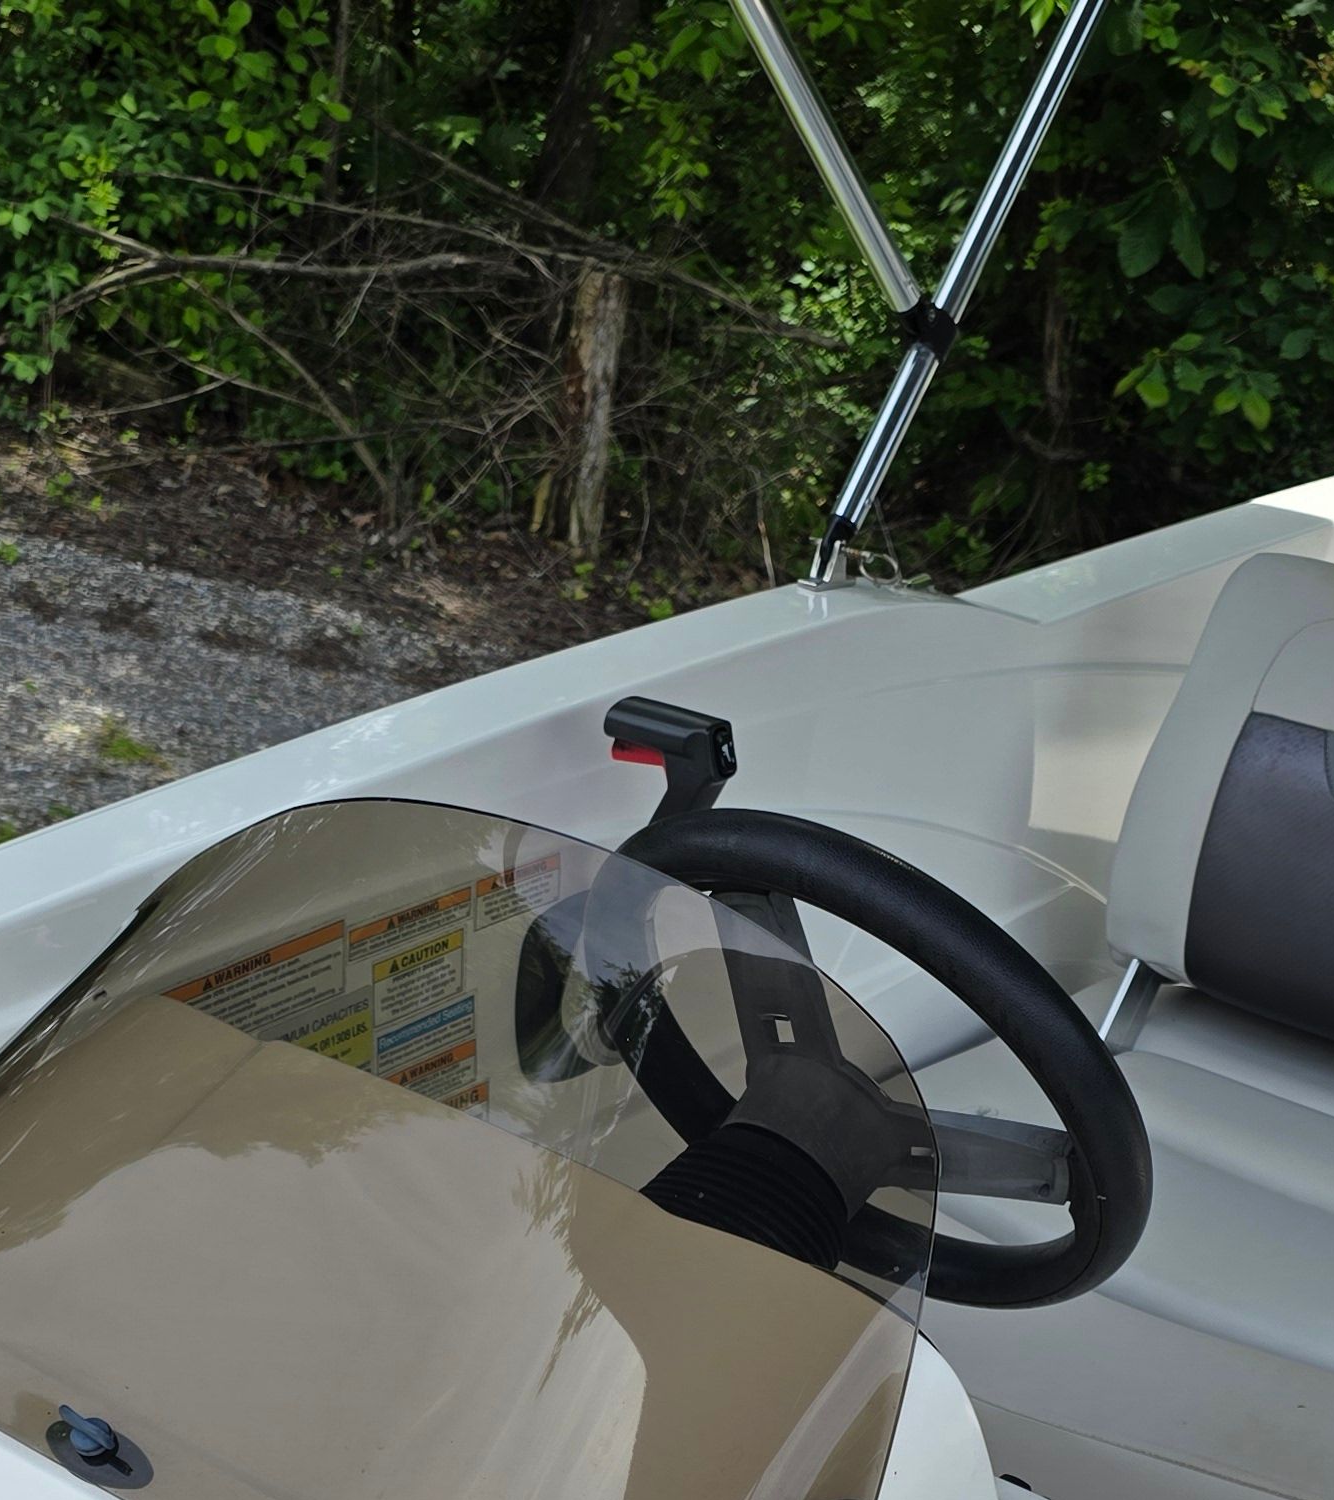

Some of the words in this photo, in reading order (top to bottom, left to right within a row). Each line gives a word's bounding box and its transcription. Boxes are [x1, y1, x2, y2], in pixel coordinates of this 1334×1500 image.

[214, 953, 271, 985] WARNING
[400, 939, 449, 967] CAUTION
[312, 998, 369, 1033] CAPACITIES
[378, 1012, 442, 1051] Recommended
[409, 1053, 454, 1079] WARNING
